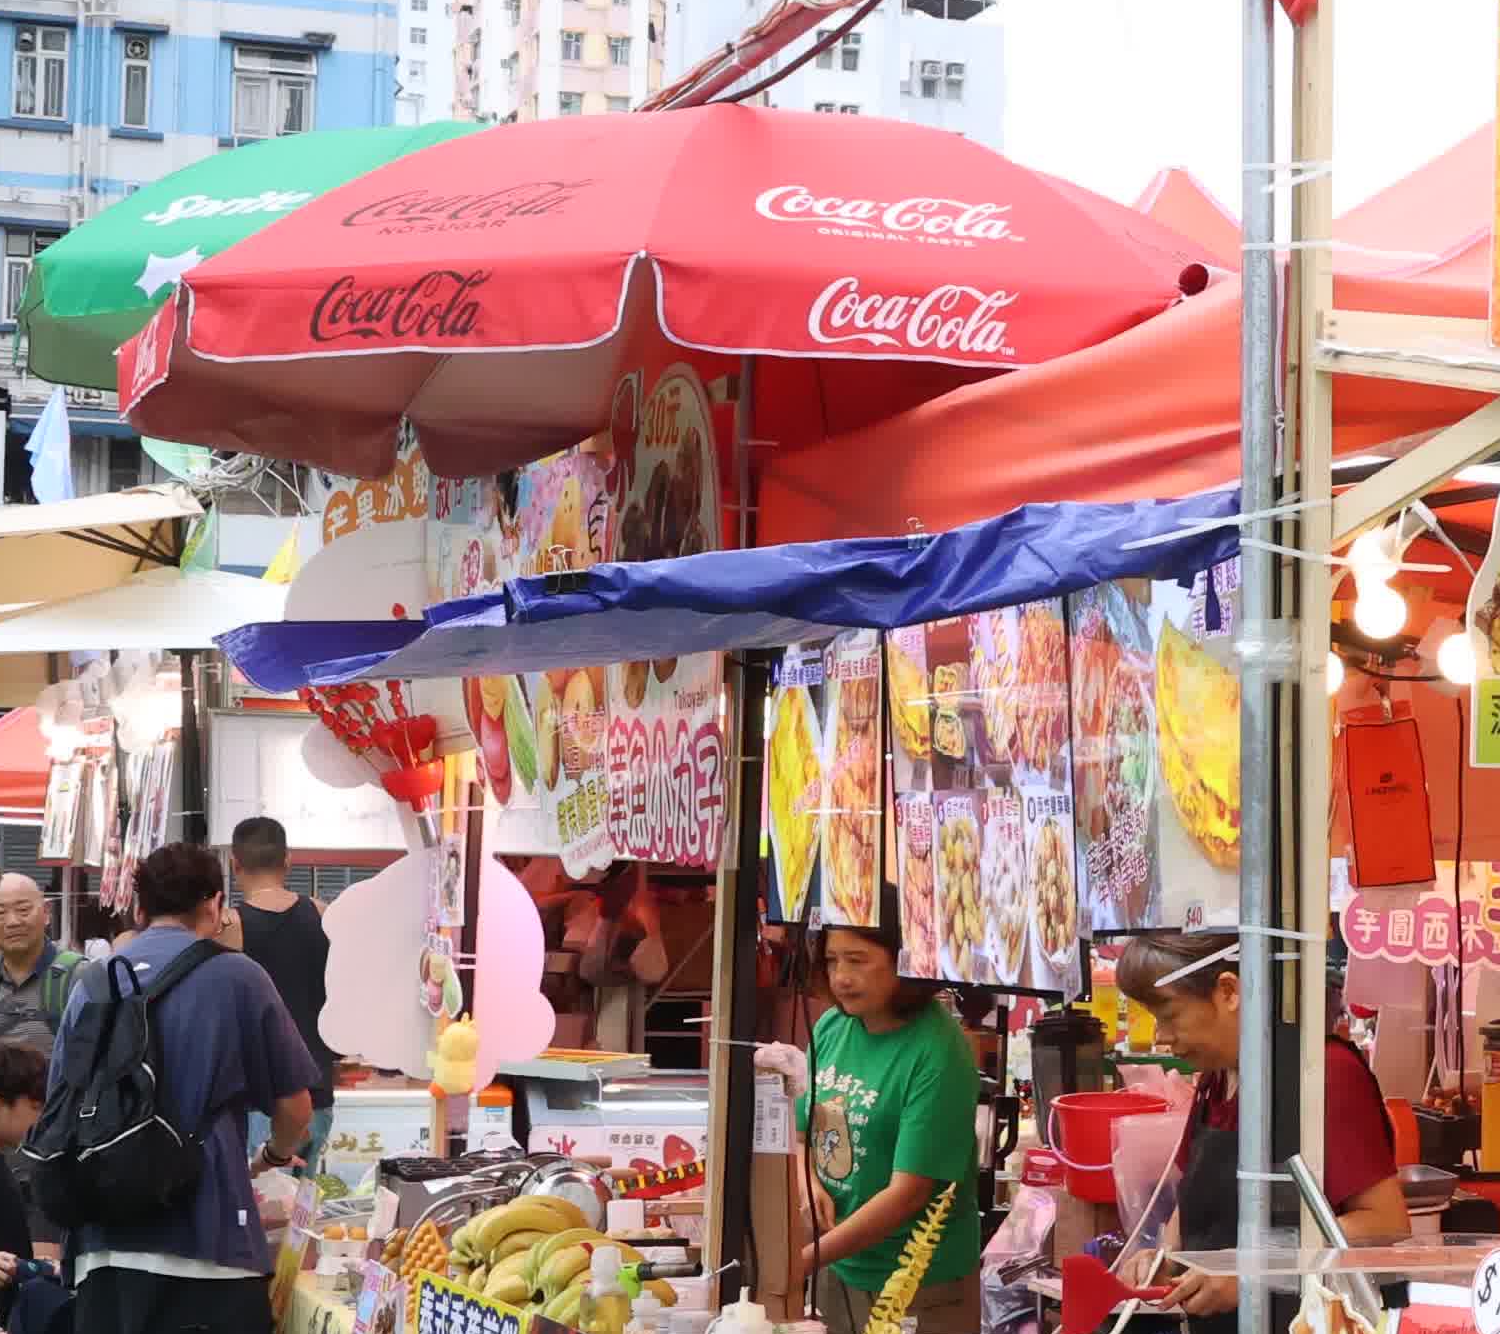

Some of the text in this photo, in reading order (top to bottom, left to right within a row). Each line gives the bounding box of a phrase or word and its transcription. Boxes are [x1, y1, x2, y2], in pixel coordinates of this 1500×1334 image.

[147, 191, 313, 226] Sprite
[340, 178, 593, 228] Coca-Cola
[378, 218, 509, 236] NO SUGAR
[755, 185, 1013, 240] Coca-Cola
[817, 227, 909, 244] ORIGINAL
[310, 269, 493, 343] Coca-Cola
[807, 276, 1020, 353] Coca-Cola
[644, 393, 680, 444] 30元
[608, 724, 724, 869] 章魚小丸子
[1186, 906, 1203, 927] $40
